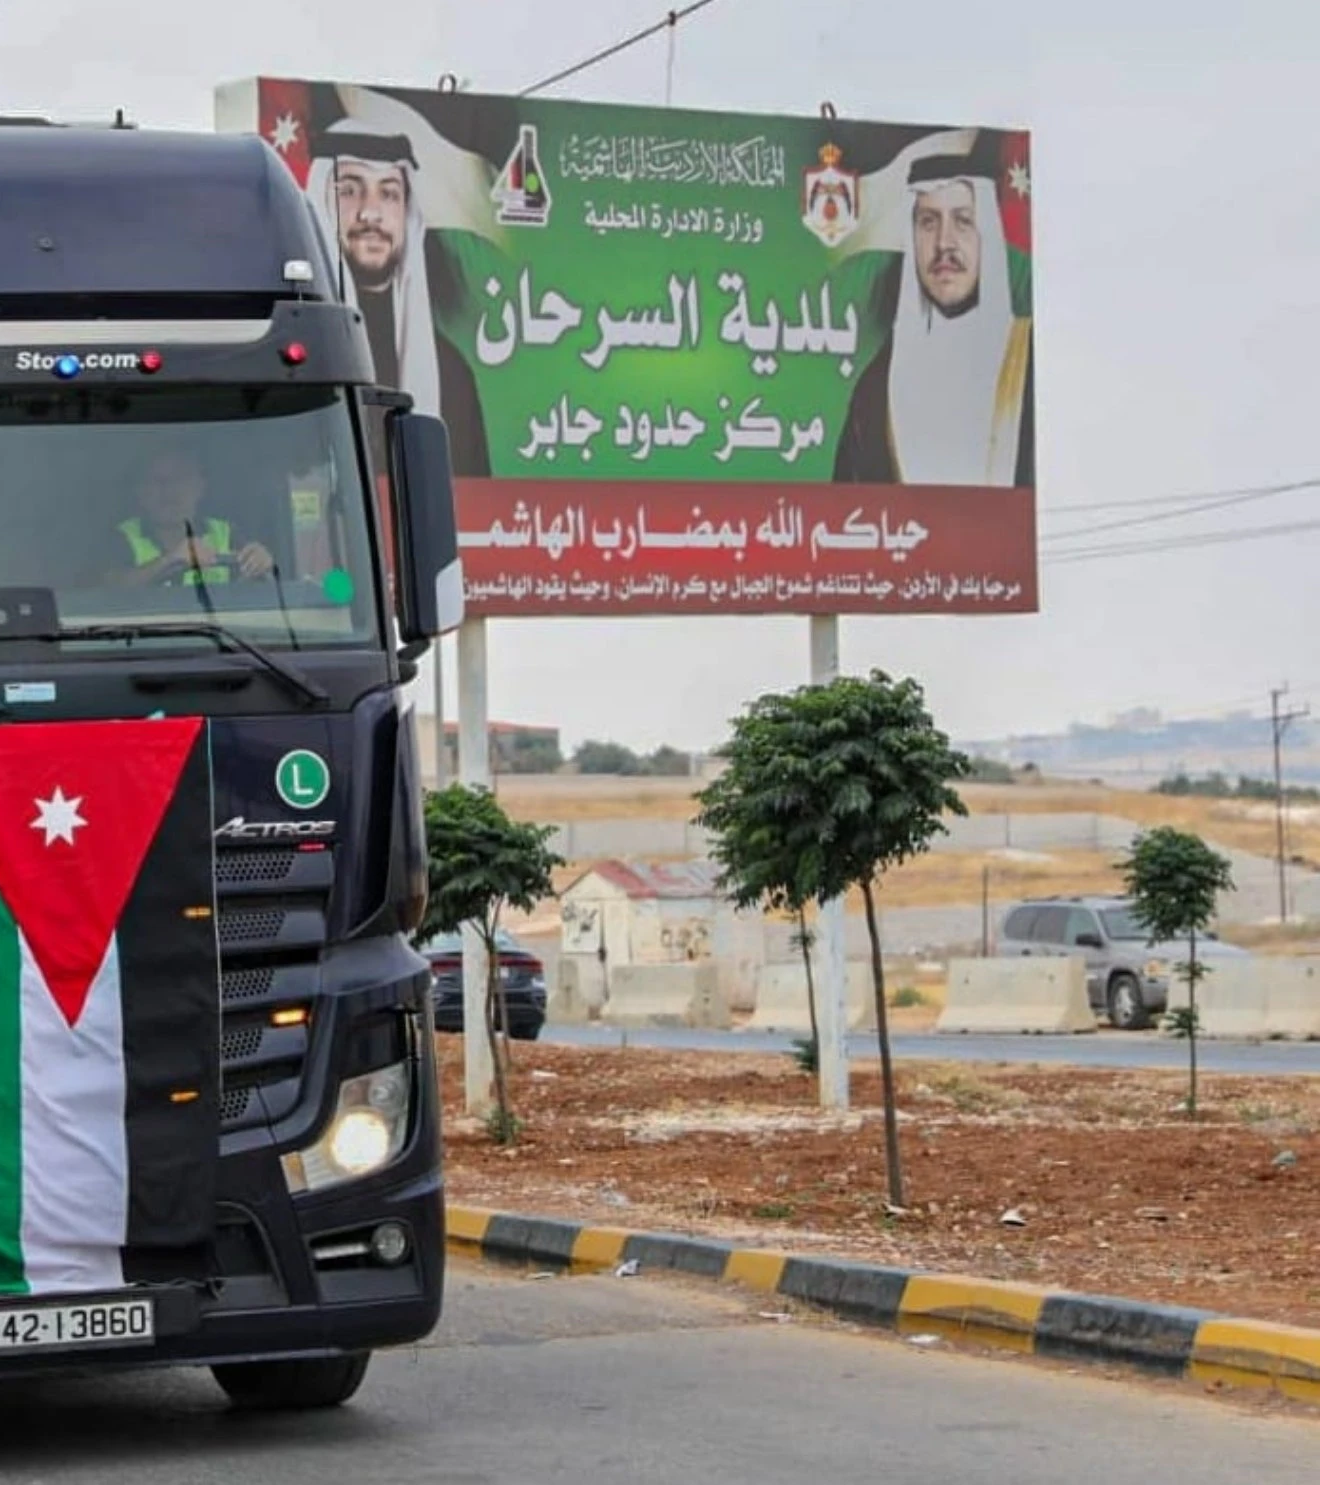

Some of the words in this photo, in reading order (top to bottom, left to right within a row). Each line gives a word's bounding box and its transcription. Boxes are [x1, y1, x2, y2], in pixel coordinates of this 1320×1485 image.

[584, 201, 646, 235] المحلية
[714, 206, 765, 242] وزارة
[475, 266, 699, 370] السرحان
[717, 271, 859, 379] بلدية
[517, 393, 603, 461] جابر
[613, 403, 706, 460] حدود
[713, 397, 824, 463] مركز
[457, 500, 585, 561] الهاشم
[755, 497, 803, 548] الله
[810, 506, 929, 563] حياكم
[535, 573, 567, 601] يقود
[568, 569, 610, 602] وحيث
[672, 573, 706, 602] كرم
[709, 579, 728, 603] مع
[864, 571, 894, 601] حيث
[943, 572, 959, 603] في
[292, 763, 314, 796] L
[212, 815, 337, 837] ACTROS
